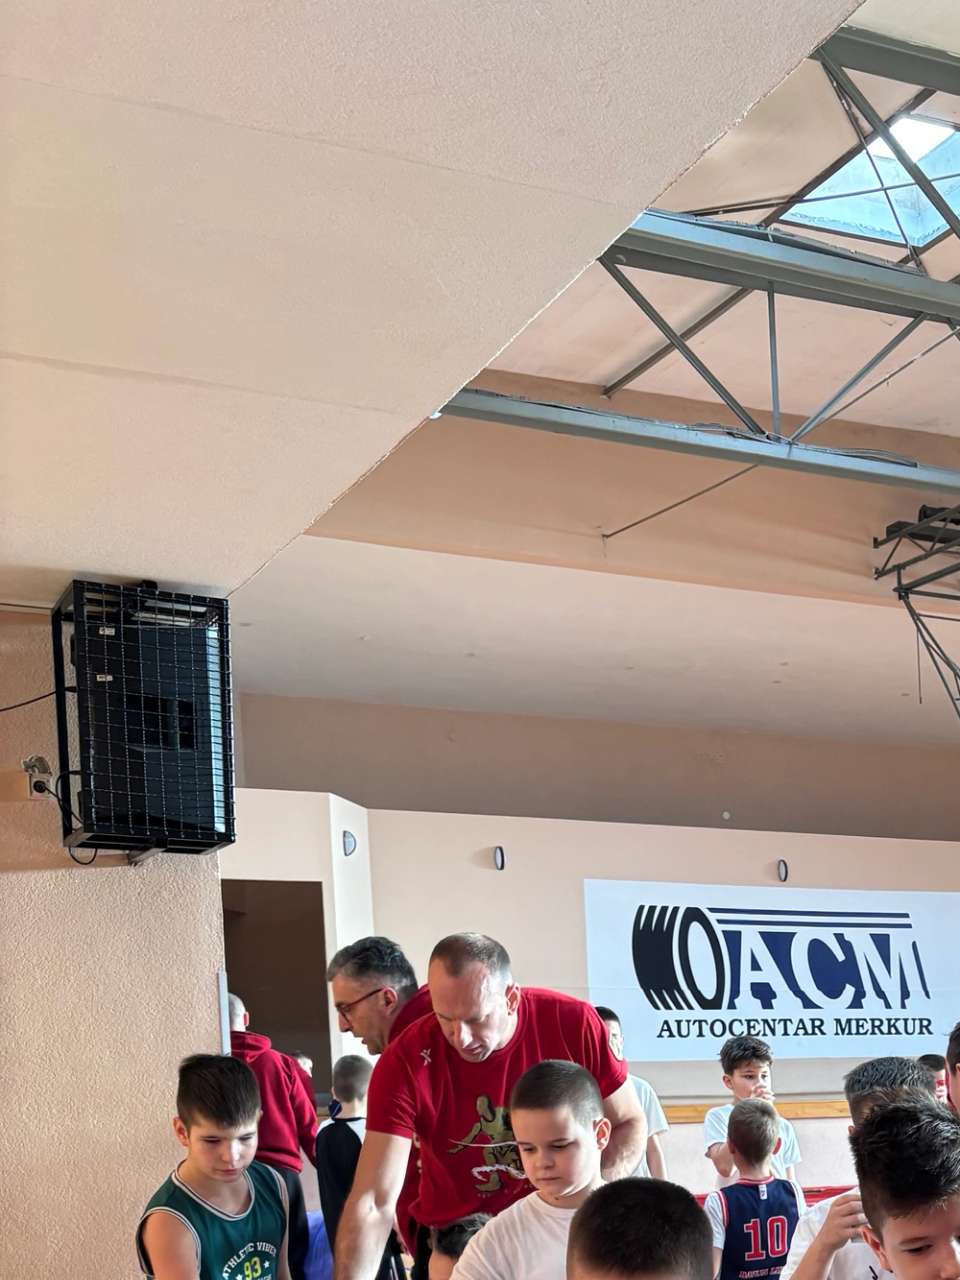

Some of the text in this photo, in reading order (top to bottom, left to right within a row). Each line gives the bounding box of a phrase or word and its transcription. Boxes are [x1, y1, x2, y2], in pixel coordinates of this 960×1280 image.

[656, 1018, 934, 1039] AUTOCENTAR MERKUR
[743, 1215, 789, 1262] 10
